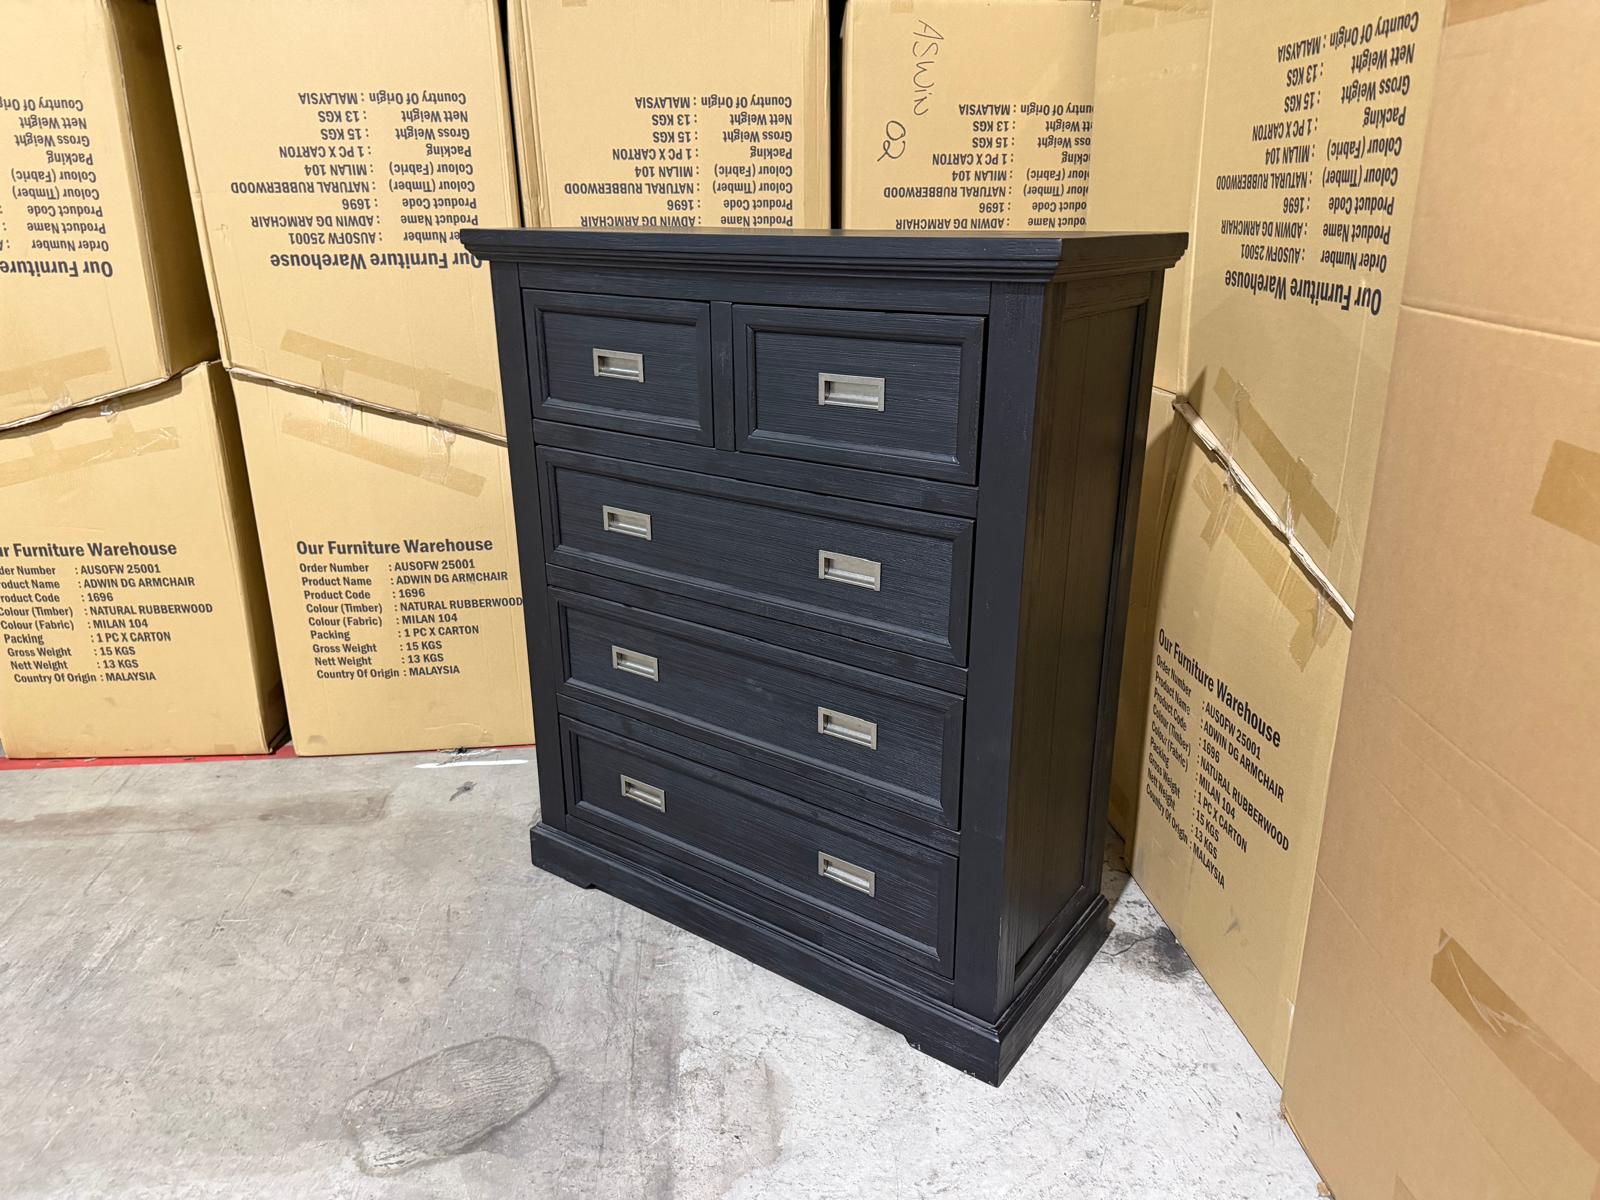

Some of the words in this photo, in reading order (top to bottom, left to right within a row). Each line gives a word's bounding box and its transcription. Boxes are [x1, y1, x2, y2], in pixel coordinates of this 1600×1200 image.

[1374, 11, 1419, 38] Country
[1330, 26, 1359, 50] Origin
[1360, 23, 1373, 45] Of
[1278, 36, 1321, 63] MALAYSIA
[1390, 43, 1415, 67] Nett
[1351, 48, 1388, 74] Weight
[1286, 67, 1305, 87] KGS
[1306, 64, 1318, 84] 13
[635, 97, 690, 109] MALAYSIA
[701, 94, 733, 109] Origin
[736, 97, 748, 109] Of
[750, 94, 792, 109] Country
[401, 108, 442, 123] Weight
[959, 104, 1010, 116] MALAYSIA
[1021, 102, 1050, 116] Origin
[1052, 105, 1064, 116] Of
[1066, 102, 1094, 116] untry
[318, 110, 342, 123] KGS
[345, 111, 360, 123] 13
[443, 111, 468, 123] Nett
[652, 131, 675, 143] KGS
[678, 132, 691, 143] 15
[723, 129, 760, 143] Weight
[762, 131, 792, 143] Gross
[932, 153, 974, 166] CARTON
[976, 153, 983, 166] X
[985, 153, 999, 165] PC
[1002, 153, 1008, 165] 1
[1061, 151, 1091, 165] cking
[11, 168, 57, 183] (Fabric)
[304, 164, 326, 176] 104
[330, 164, 367, 176] MILAN
[389, 161, 434, 176] (Fabric)
[436, 164, 474, 176] Colour
[634, 166, 655, 178] 104
[659, 166, 693, 178] MILAN
[714, 164, 756, 178] (Fabric)
[758, 165, 793, 177] Colour
[59, 171, 97, 183] Colour
[1216, 173, 1269, 190] RUBBERWOOD
[1270, 171, 1308, 189] NATURAL
[1322, 165, 1363, 188] (Timber)
[1364, 167, 1398, 187] Colour
[12, 186, 60, 200] (Timber)
[63, 188, 100, 200] Colour
[564, 183, 643, 195] RUBBERWOOD
[645, 183, 694, 194] NATURAL
[712, 180, 756, 194] (Timber)
[758, 182, 793, 194] Colour
[342, 198, 371, 210] 1696
[402, 198, 431, 210] Code
[433, 198, 477, 209] Product
[979, 202, 1005, 213] 1696
[1032, 202, 1057, 213] Code
[1059, 202, 1087, 213] oduct
[1283, 197, 1305, 214] 1696
[1328, 197, 1353, 215] Code
[1354, 197, 1395, 216] Product
[27, 205, 56, 217] Code
[57, 206, 103, 217] Product
[250, 216, 313, 228] ARMCHAIR
[316, 216, 333, 227] DG
[335, 215, 374, 227] ADWIN
[400, 215, 433, 226] Name
[434, 214, 479, 226] Product
[27, 222, 60, 234] Name
[61, 223, 106, 235] Product
[32, 240, 76, 252] Number
[78, 240, 109, 252] Order
[1241, 244, 1265, 261] 25001
[370, 253, 448, 269] Furniture
[1266, 245, 1301, 264] AUSOFW
[1320, 250, 1358, 270] Number
[0, 261, 79, 277] Furniture
[270, 254, 367, 270] Warehouse
[1358, 253, 1387, 273] Order
[83, 261, 113, 278] Our
[1225, 270, 1286, 300] Warehouse
[1290, 278, 1352, 311] Furniture
[1354, 287, 1382, 316] Our
[12, 543, 85, 557] Furniture
[87, 542, 177, 556] Warehouse
[296, 540, 324, 555] Our
[327, 540, 400, 554] Furniture
[403, 538, 493, 553] Warehouse
[299, 563, 327, 572] Order
[329, 562, 369, 572] Number
[394, 560, 439, 571] AUSOFW
[441, 558, 475, 570] 25001
[301, 576, 341, 586] Product
[342, 576, 372, 586] Name
[396, 574, 432, 585] ADWIN
[434, 574, 449, 583] DG
[451, 571, 508, 583] ARMCHAIR
[303, 590, 343, 600] Product
[344, 590, 371, 599] Code
[398, 588, 425, 598] 1696
[31, 606, 73, 618] (Timber)
[89, 605, 137, 615] NATURAL
[138, 603, 213, 614] RUBBERWOOD
[306, 603, 338, 613] Colour
[340, 603, 382, 614] (Timber)
[400, 600, 448, 611] NATURAL
[449, 596, 523, 609] RUBBERWOOD
[0, 620, 32, 630] Colour
[34, 620, 74, 631] (Fabric)
[92, 619, 126, 629] MILAN
[128, 618, 148, 628] 104
[308, 616, 340, 626] Colour
[342, 616, 382, 628] (Fabric)
[402, 614, 435, 624] MILAN
[438, 613, 458, 622] 104
[3, 633, 44, 645] Packing
[96, 632, 103, 643] 1
[104, 632, 119, 642] PC
[120, 632, 128, 642] X
[129, 631, 171, 642] CARTON
[14, 673, 52, 684] Country
[54, 673, 65, 682] Of
[67, 672, 97, 684] Origin
[105, 671, 156, 681] MALAYSIA
[316, 669, 355, 680] Country
[356, 668, 368, 678] Of
[370, 668, 400, 679] Origin
[409, 665, 460, 676] MALAYSIA
[1159, 628, 1172, 654] Our
[1174, 642, 1214, 692] Furniture
[1217, 679, 1280, 748] Warehouse
[1156, 654, 1170, 675] Order
[1171, 668, 1192, 697] Number
[1205, 702, 1236, 736] AUSOFW
[1236, 729, 1260, 760] 25001
[1156, 671, 1174, 699] Product
[1174, 691, 1190, 715] Name
[1204, 721, 1226, 750] ADWIN
[1228, 741, 1239, 761] DG
[1240, 754, 1284, 802] ARMCHAIR
[1152, 704, 1168, 729] Colour
[1168, 722, 1191, 756] (Timber)
[1200, 756, 1230, 795] NATURAL
[1232, 786, 1289, 851] RUBBERWOOD
[1146, 784, 1164, 816] Country
[1172, 817, 1188, 844] Origin
[1193, 842, 1225, 889] MALAYSIA
